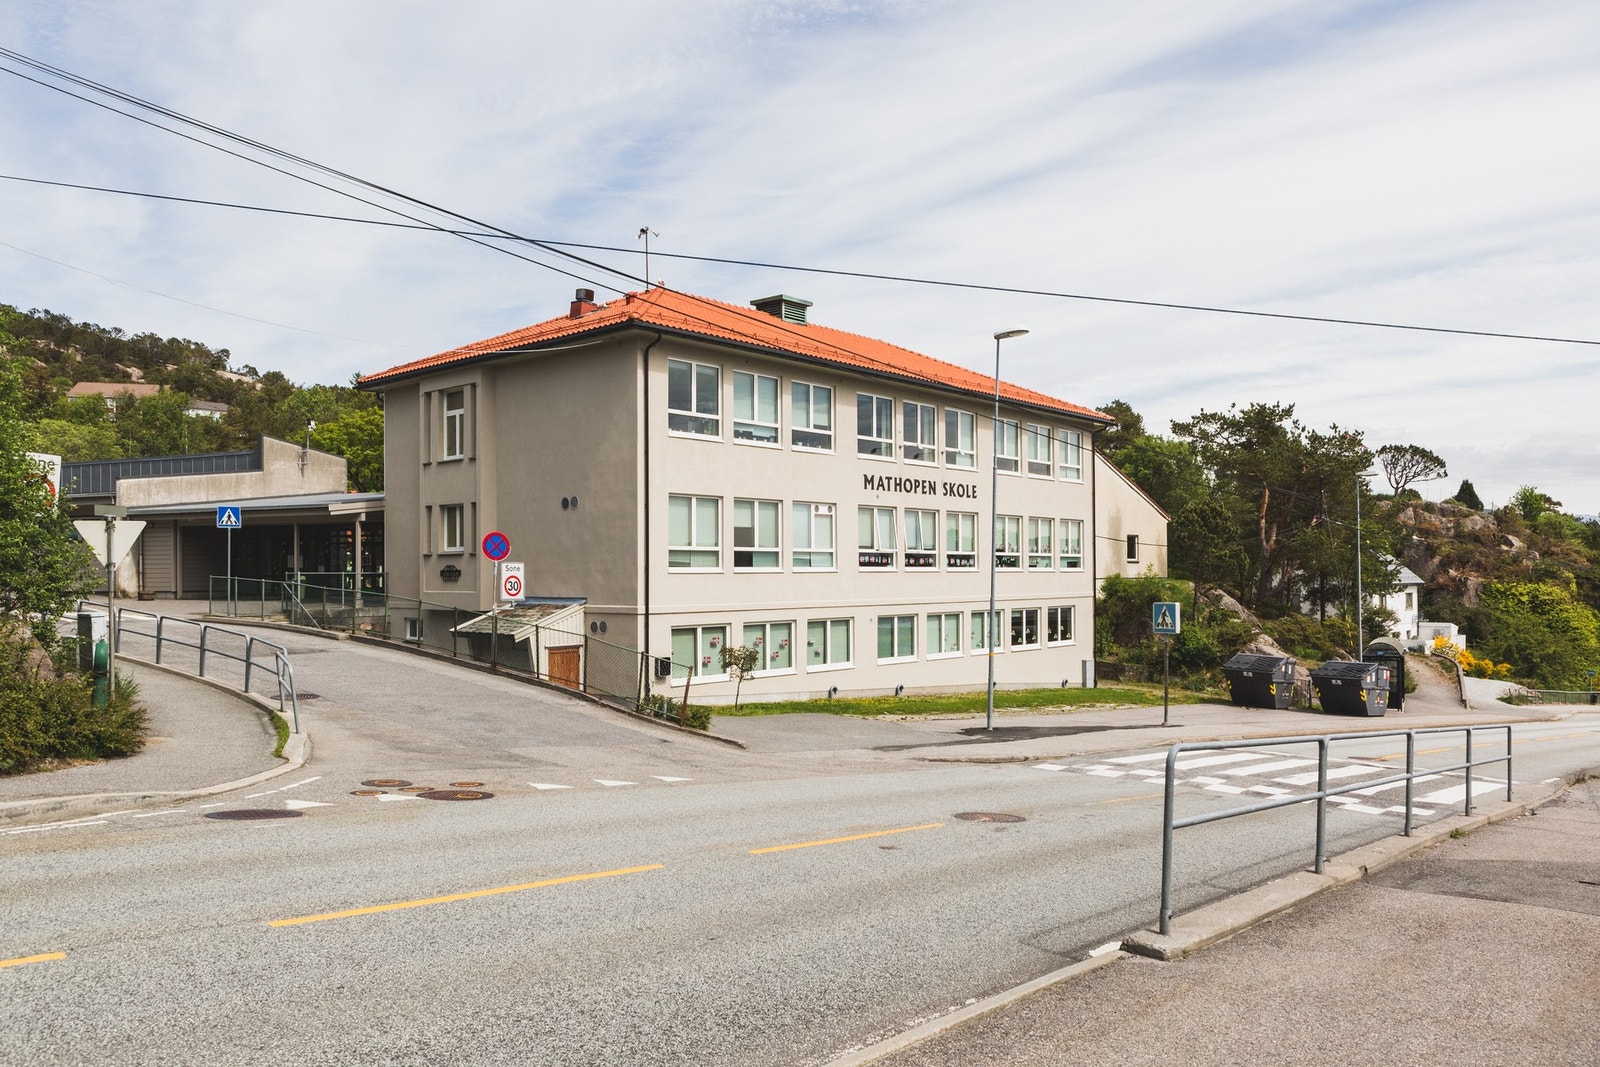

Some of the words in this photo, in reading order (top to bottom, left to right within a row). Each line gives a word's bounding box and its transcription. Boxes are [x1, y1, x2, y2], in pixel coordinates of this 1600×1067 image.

[863, 474, 937, 496] MATHOPEN
[942, 481, 977, 499] SKOLE
[505, 564, 521, 572] Sone
[507, 580, 519, 592] 30
